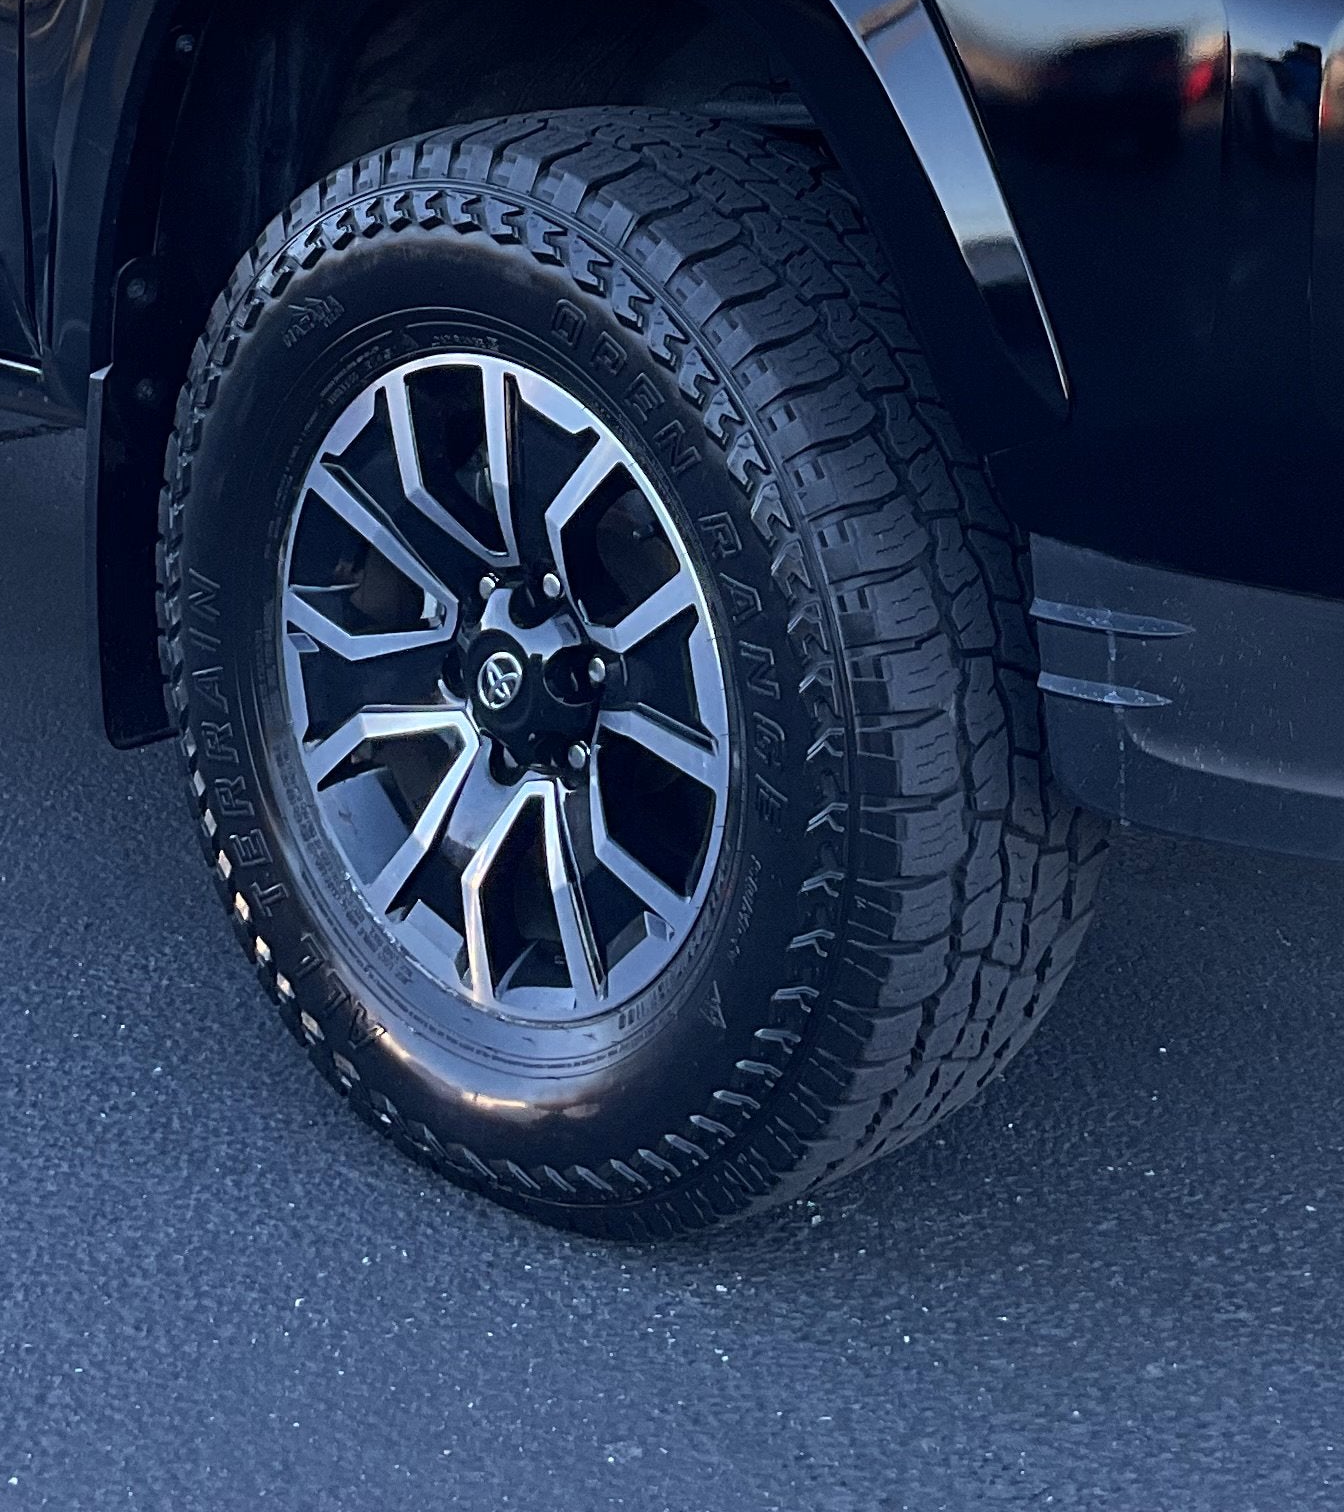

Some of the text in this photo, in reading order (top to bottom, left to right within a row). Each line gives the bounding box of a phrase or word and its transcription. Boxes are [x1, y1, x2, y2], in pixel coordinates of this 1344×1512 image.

[187, 567, 290, 918] TERRAIN
[550, 297, 789, 833] OPEN RANGE
